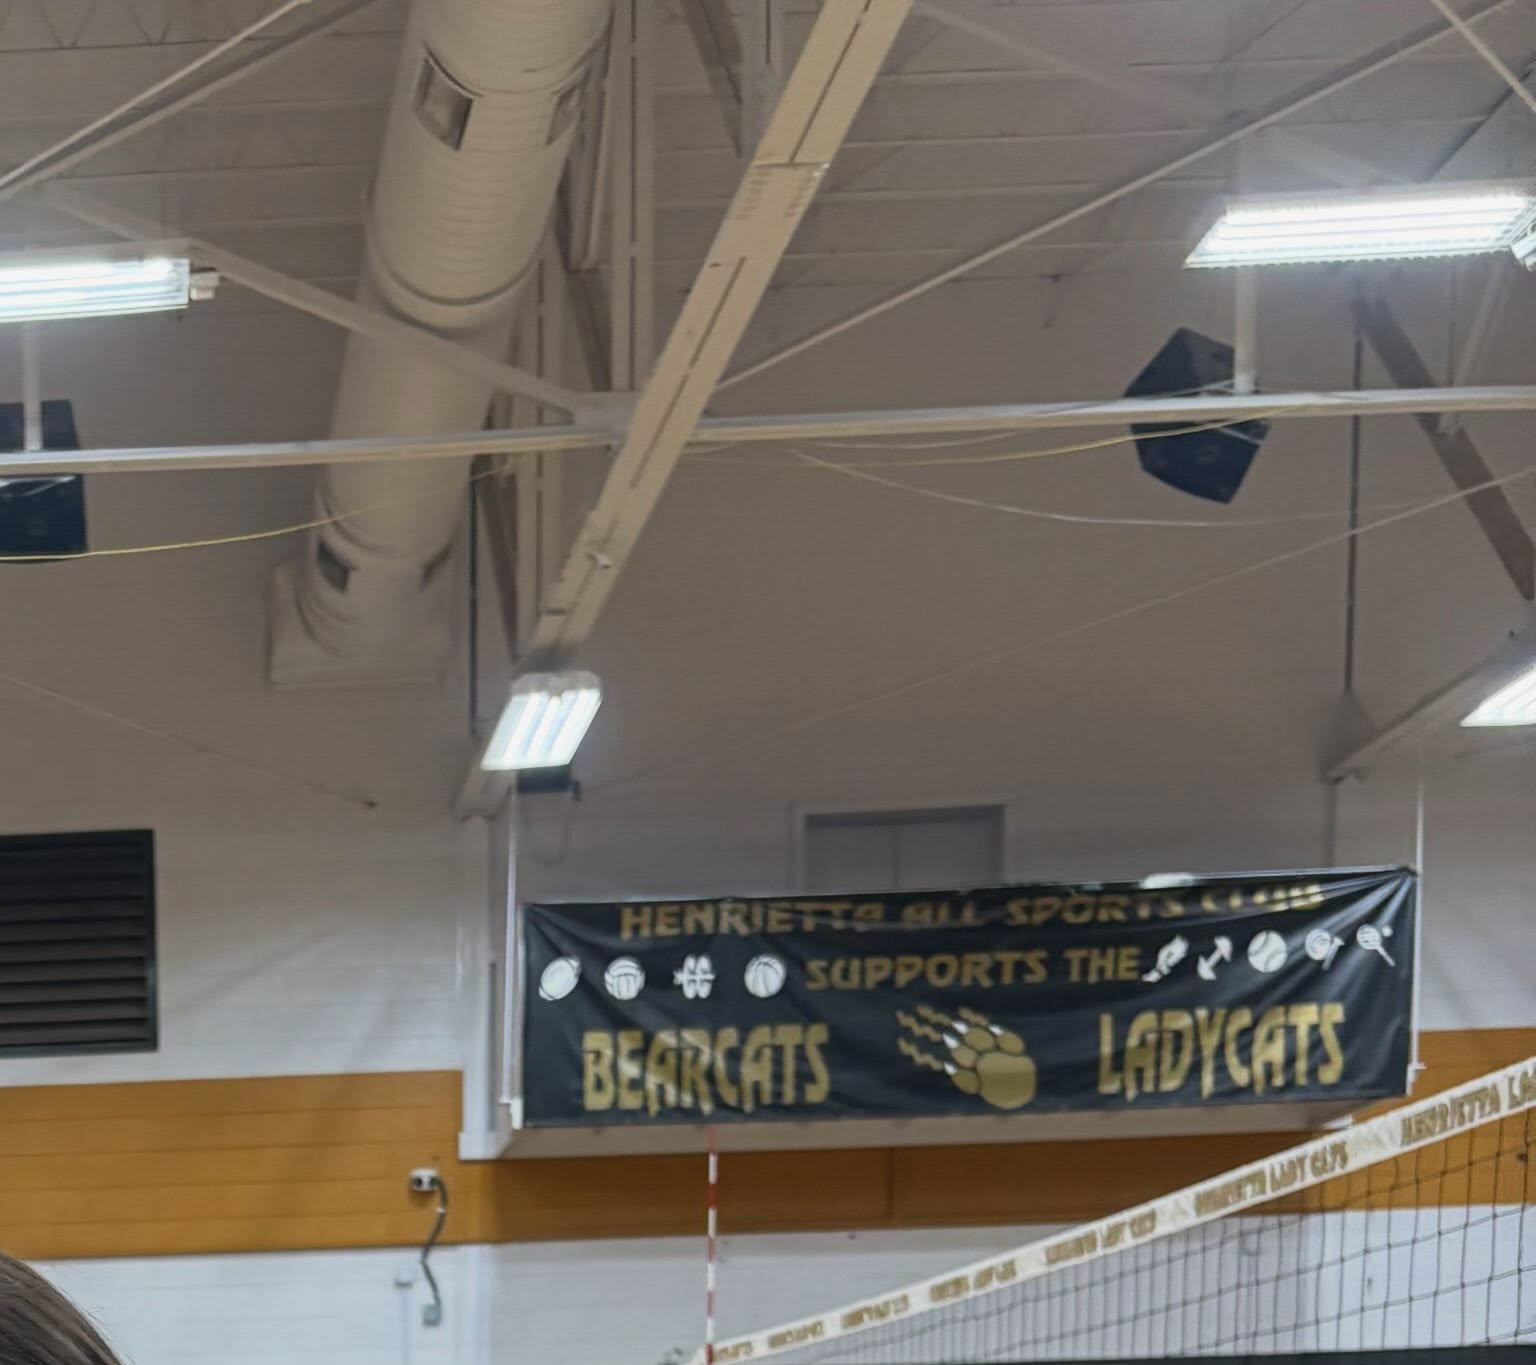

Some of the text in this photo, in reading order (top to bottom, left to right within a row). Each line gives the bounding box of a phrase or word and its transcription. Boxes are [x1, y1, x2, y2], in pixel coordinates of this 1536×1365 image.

[621, 901, 884, 940] HENRIETTA
[1006, 891, 1184, 926] SPORTS
[805, 946, 1141, 991] SUPPORTS THE
[582, 1022, 831, 1117] BEARCATS
[1098, 1002, 1346, 1101] LADYCATS
